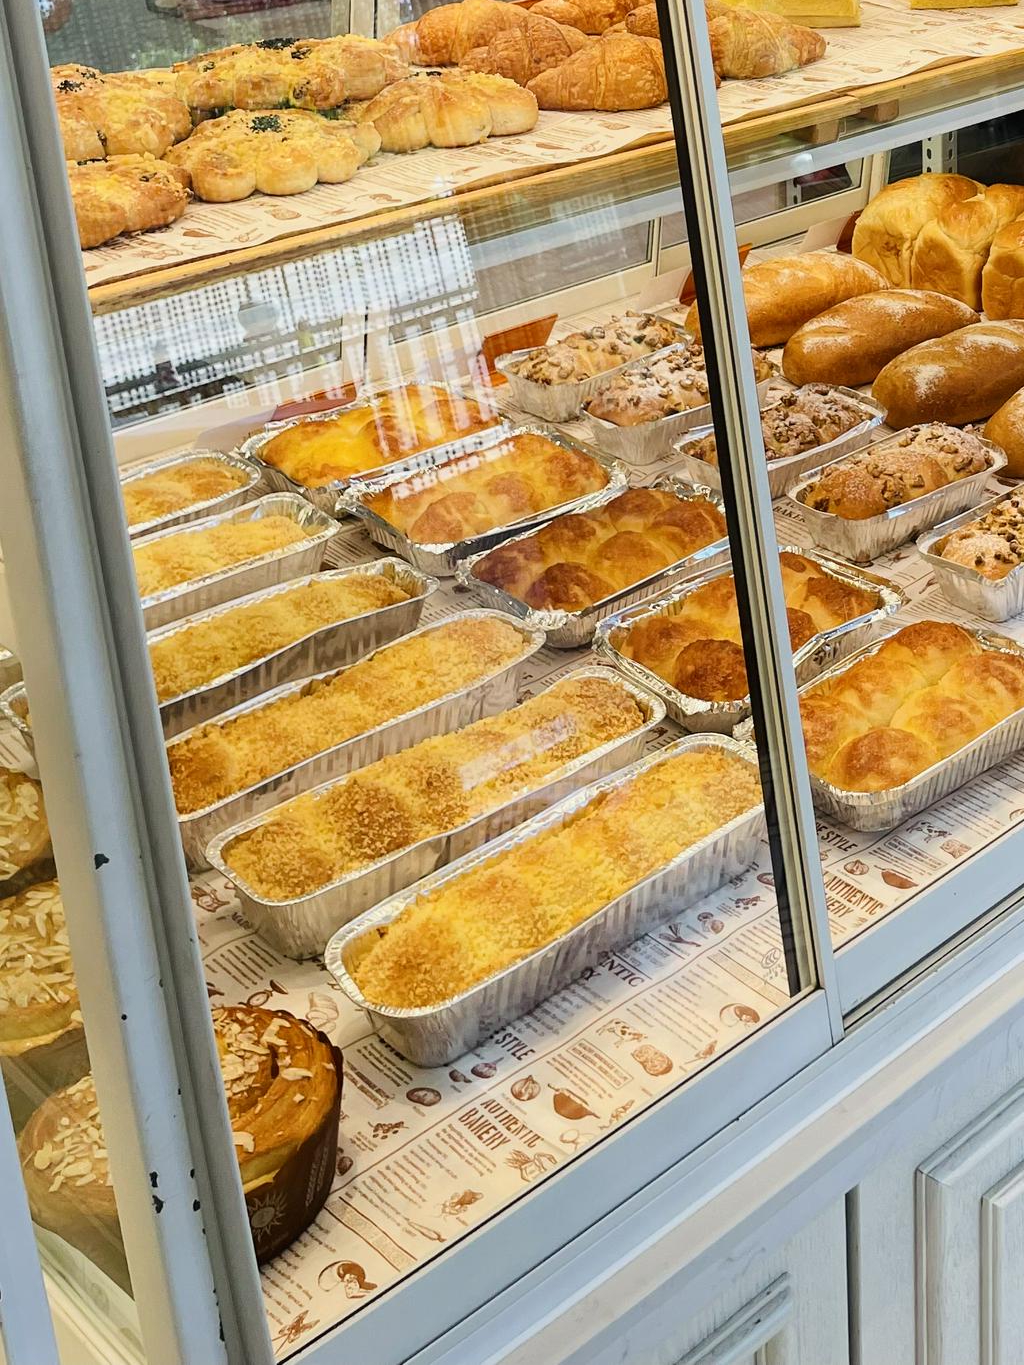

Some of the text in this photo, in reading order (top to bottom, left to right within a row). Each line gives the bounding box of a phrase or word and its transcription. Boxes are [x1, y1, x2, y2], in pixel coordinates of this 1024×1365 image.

[821, 829, 858, 852] STYLE
[495, 1032, 536, 1061] STYLE
[458, 1107, 511, 1151] BAKERY
[480, 1098, 545, 1149] AUTHENTIC
